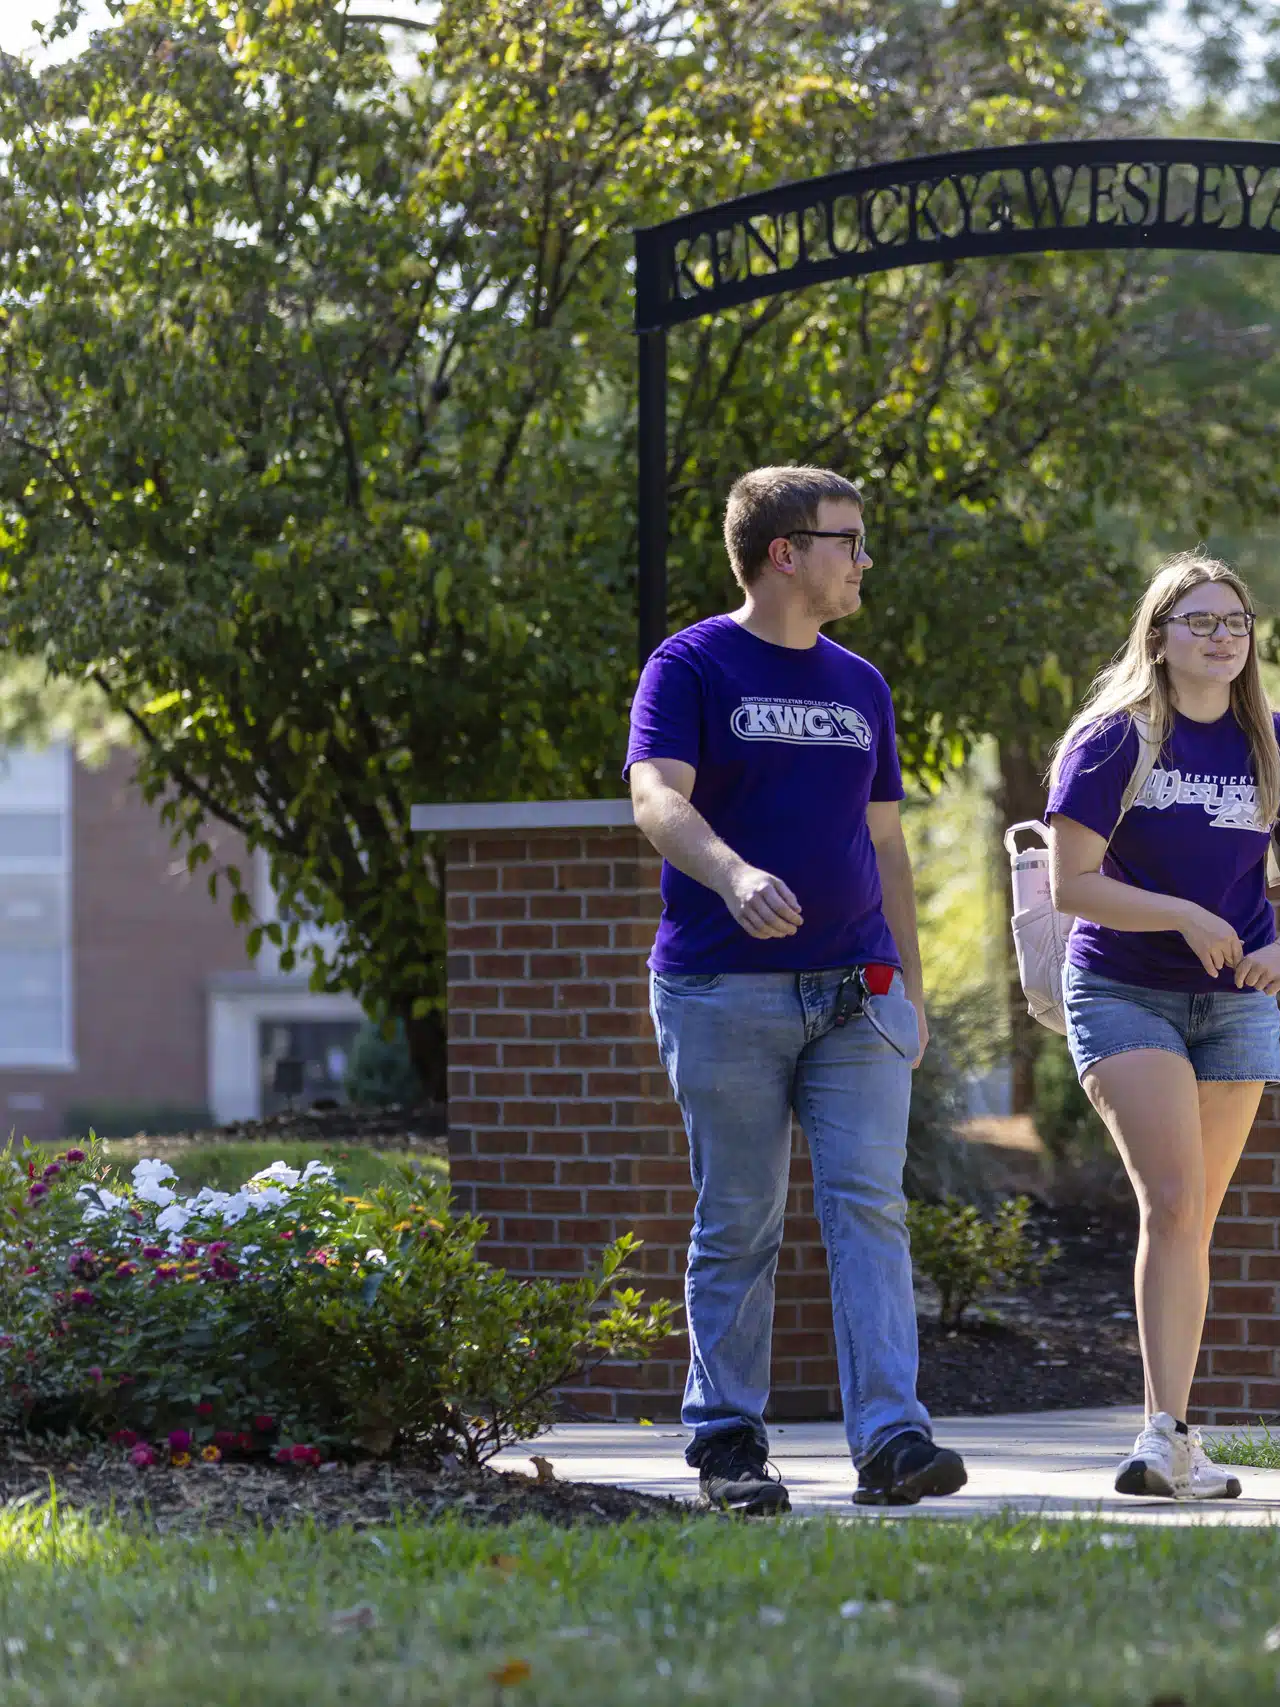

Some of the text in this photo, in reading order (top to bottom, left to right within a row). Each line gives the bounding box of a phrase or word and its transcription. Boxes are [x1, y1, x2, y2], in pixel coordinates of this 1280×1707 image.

[669, 172, 990, 300] KENTUCKY
[773, 697, 803, 705] WESLEYAN
[744, 703, 833, 737] KWC
[1185, 772, 1255, 785] KENTUCKY
